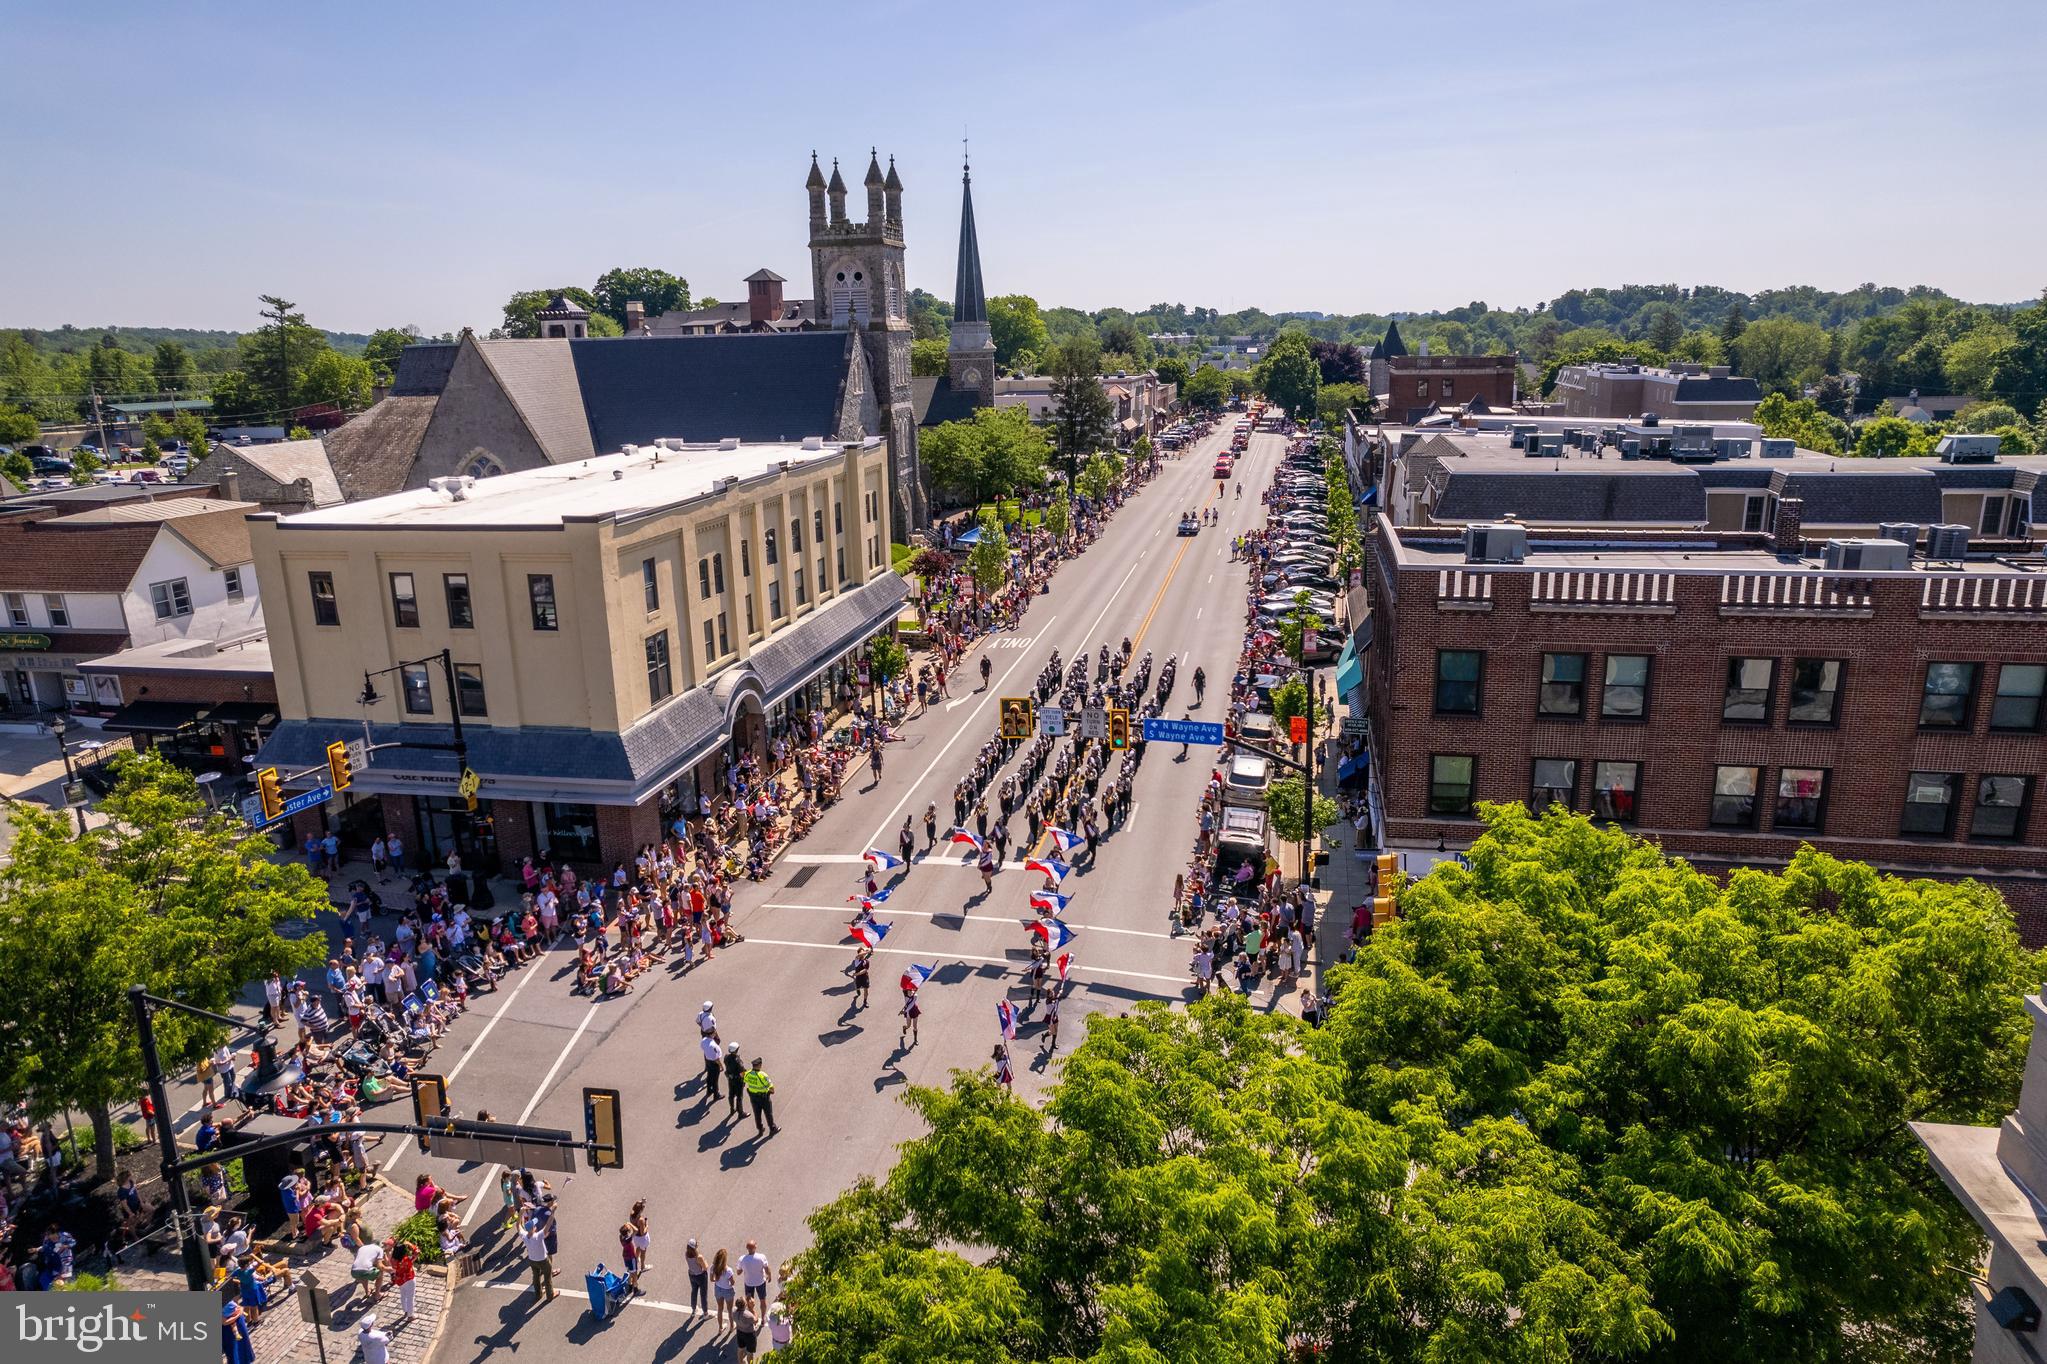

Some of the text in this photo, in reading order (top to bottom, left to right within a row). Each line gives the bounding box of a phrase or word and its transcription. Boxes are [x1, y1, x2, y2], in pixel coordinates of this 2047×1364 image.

[1162, 722, 1217, 732] N Wayne Ave
[1149, 730, 1205, 741] S Wayne Ave
[307, 792, 321, 804] Ave
